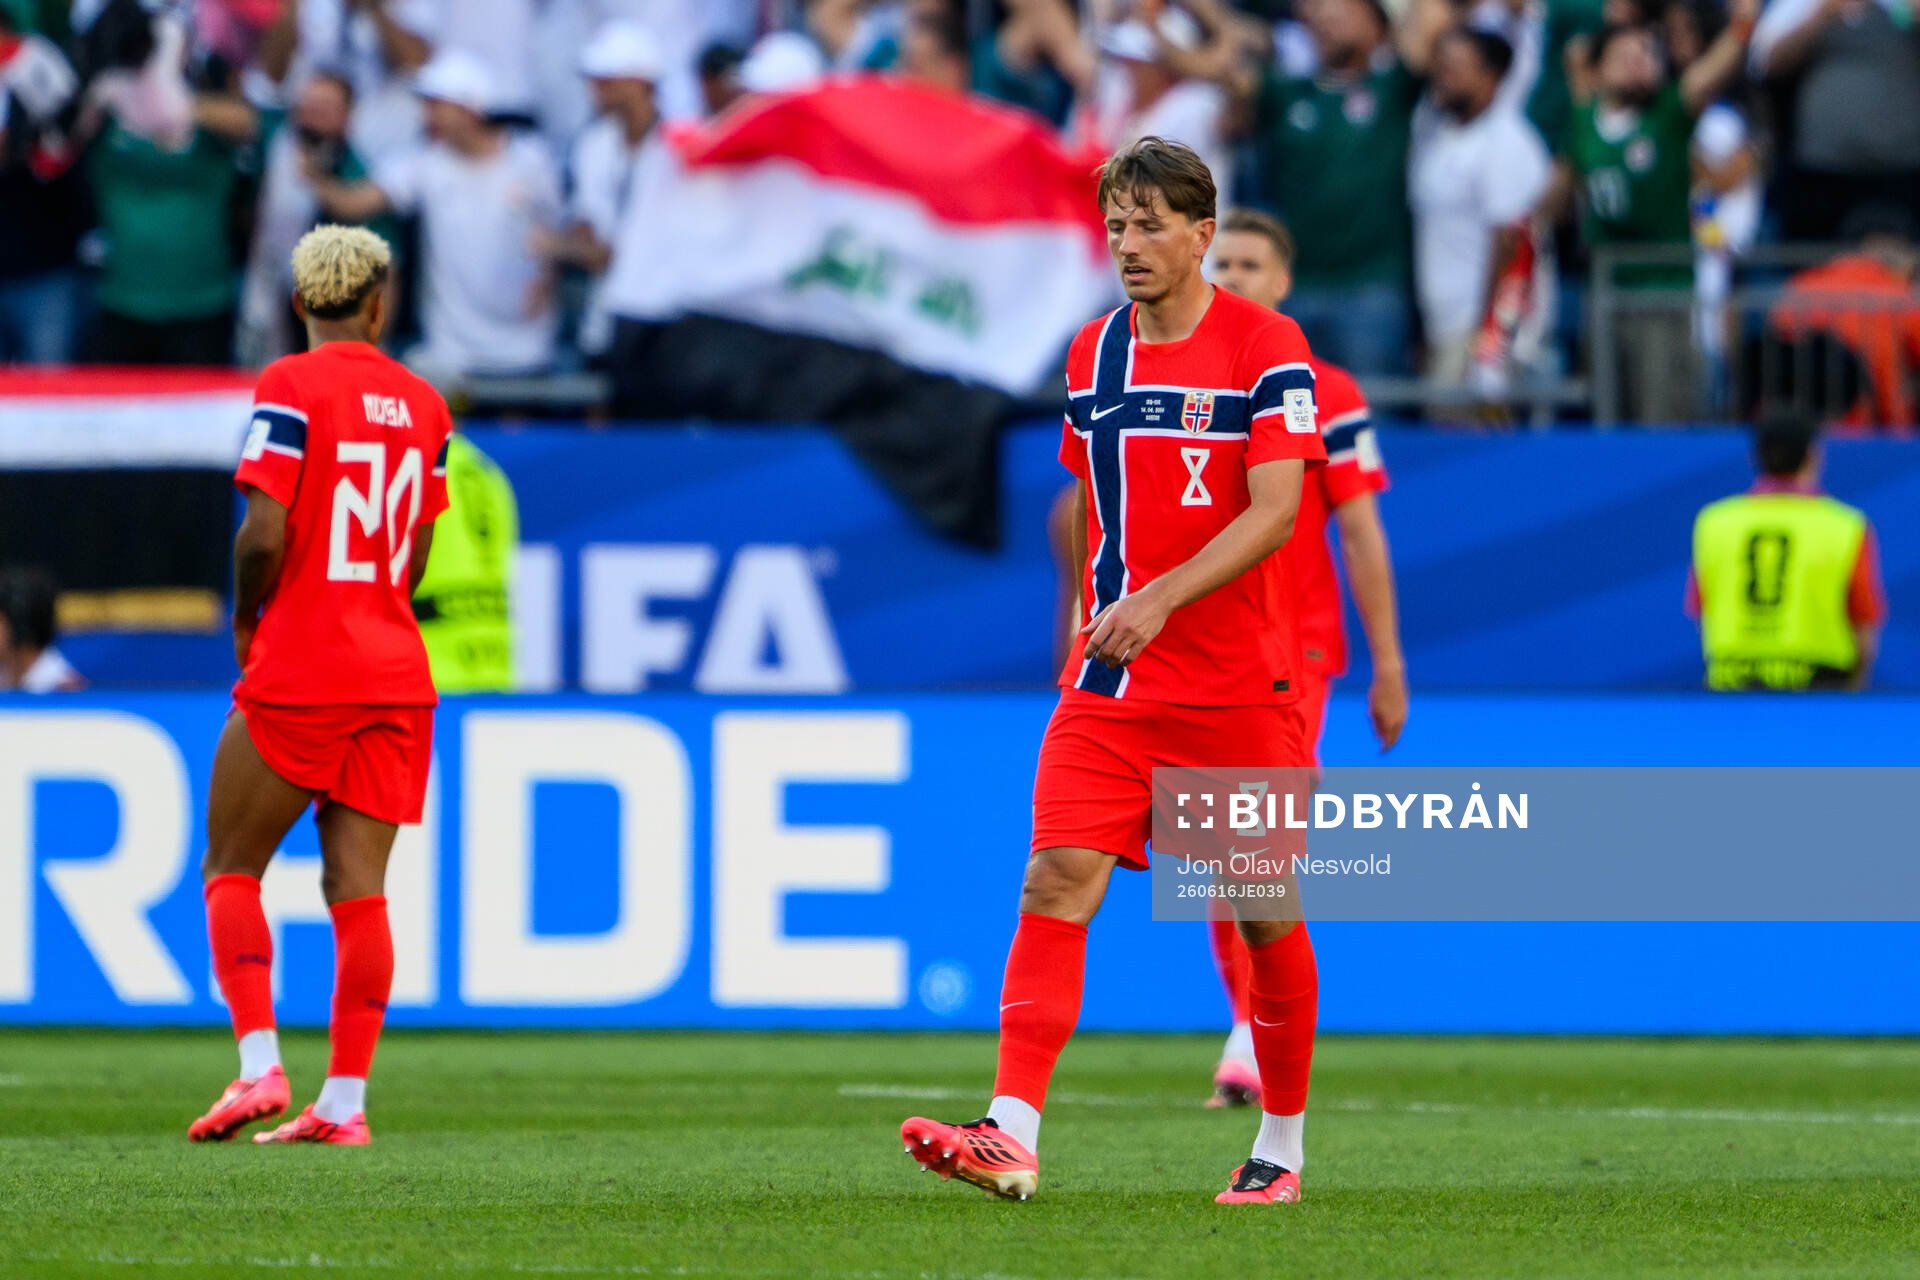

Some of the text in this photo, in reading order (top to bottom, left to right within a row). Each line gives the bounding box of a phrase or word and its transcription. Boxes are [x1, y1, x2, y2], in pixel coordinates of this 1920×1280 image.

[327, 440, 423, 588] 20
[1181, 447, 1212, 506] 8
[511, 542, 849, 693] IFA
